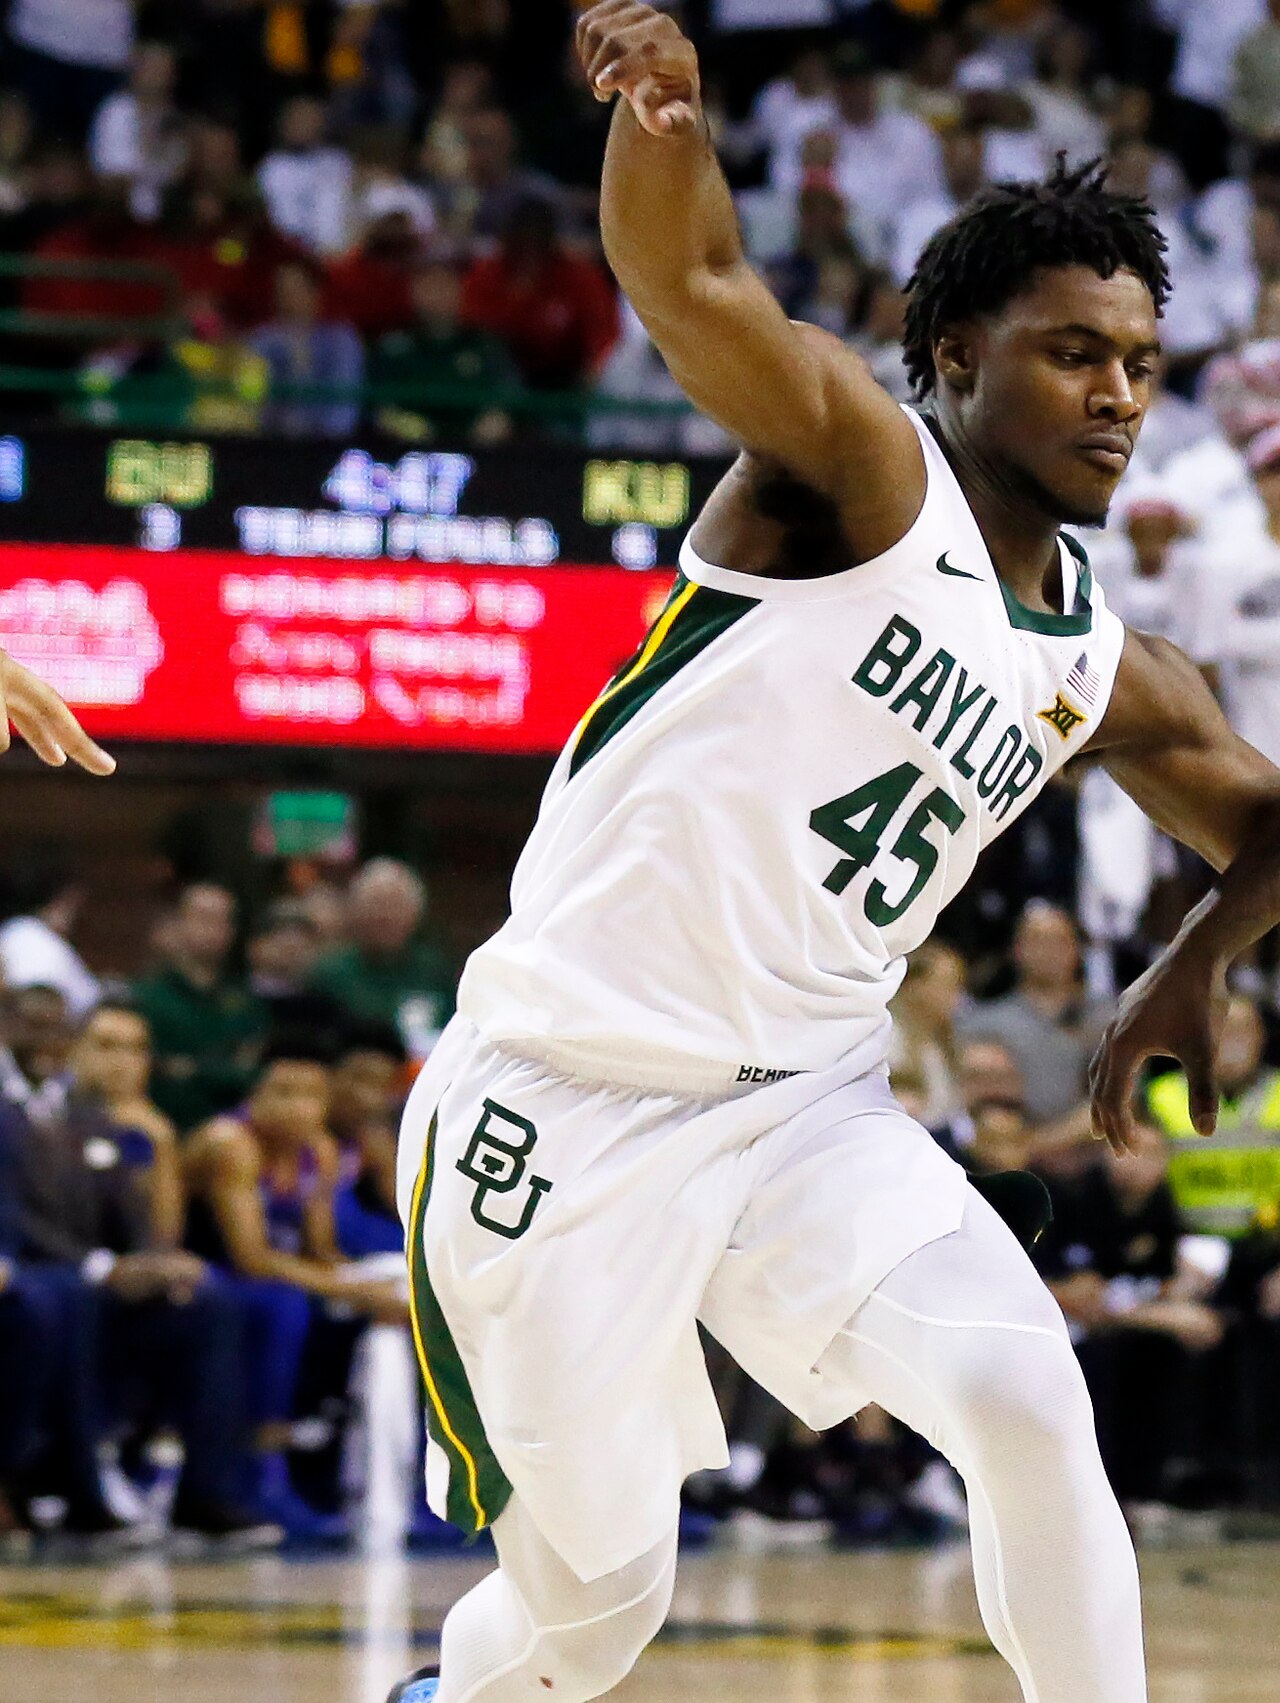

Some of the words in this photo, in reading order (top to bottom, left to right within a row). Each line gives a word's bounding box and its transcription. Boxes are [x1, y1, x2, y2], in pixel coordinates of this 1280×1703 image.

[851, 613, 1043, 823] BAYLOR
[808, 761, 966, 927] 45
[455, 1096, 554, 1240] BU
